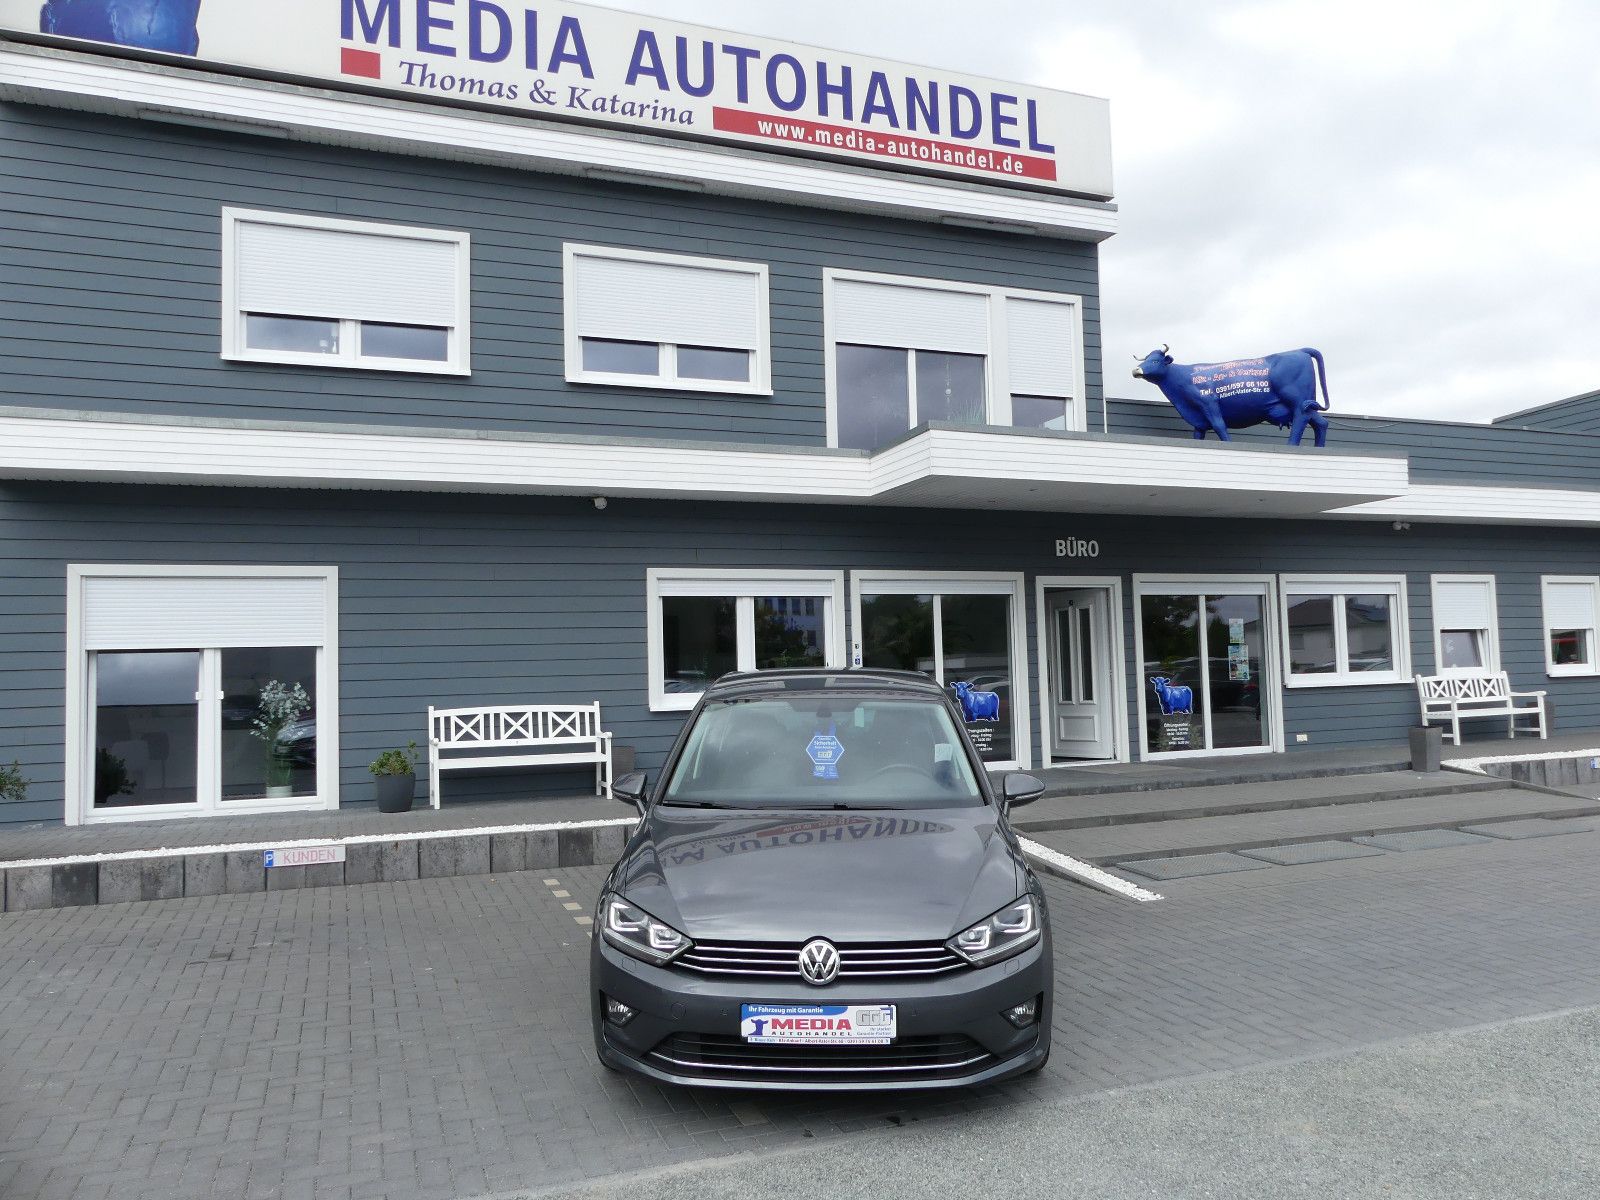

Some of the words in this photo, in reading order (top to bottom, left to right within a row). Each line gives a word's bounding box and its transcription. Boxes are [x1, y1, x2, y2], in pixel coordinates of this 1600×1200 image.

[340, 0, 595, 80] MEDIA
[625, 29, 1055, 154] AUTOHANDEL
[399, 60, 519, 101] Thomas
[528, 78, 557, 106] &
[565, 85, 694, 126] Katarina
[757, 118, 1024, 174] www.media-autohandel.de
[1256, 380, 1269, 388] 100
[1055, 536, 1100, 557] BÜRO
[283, 849, 335, 864] KUNDEN
[758, 1006, 785, 1014] Fahrzeug
[797, 1006, 824, 1014] Garantie
[771, 1018, 852, 1030] MEDIA
